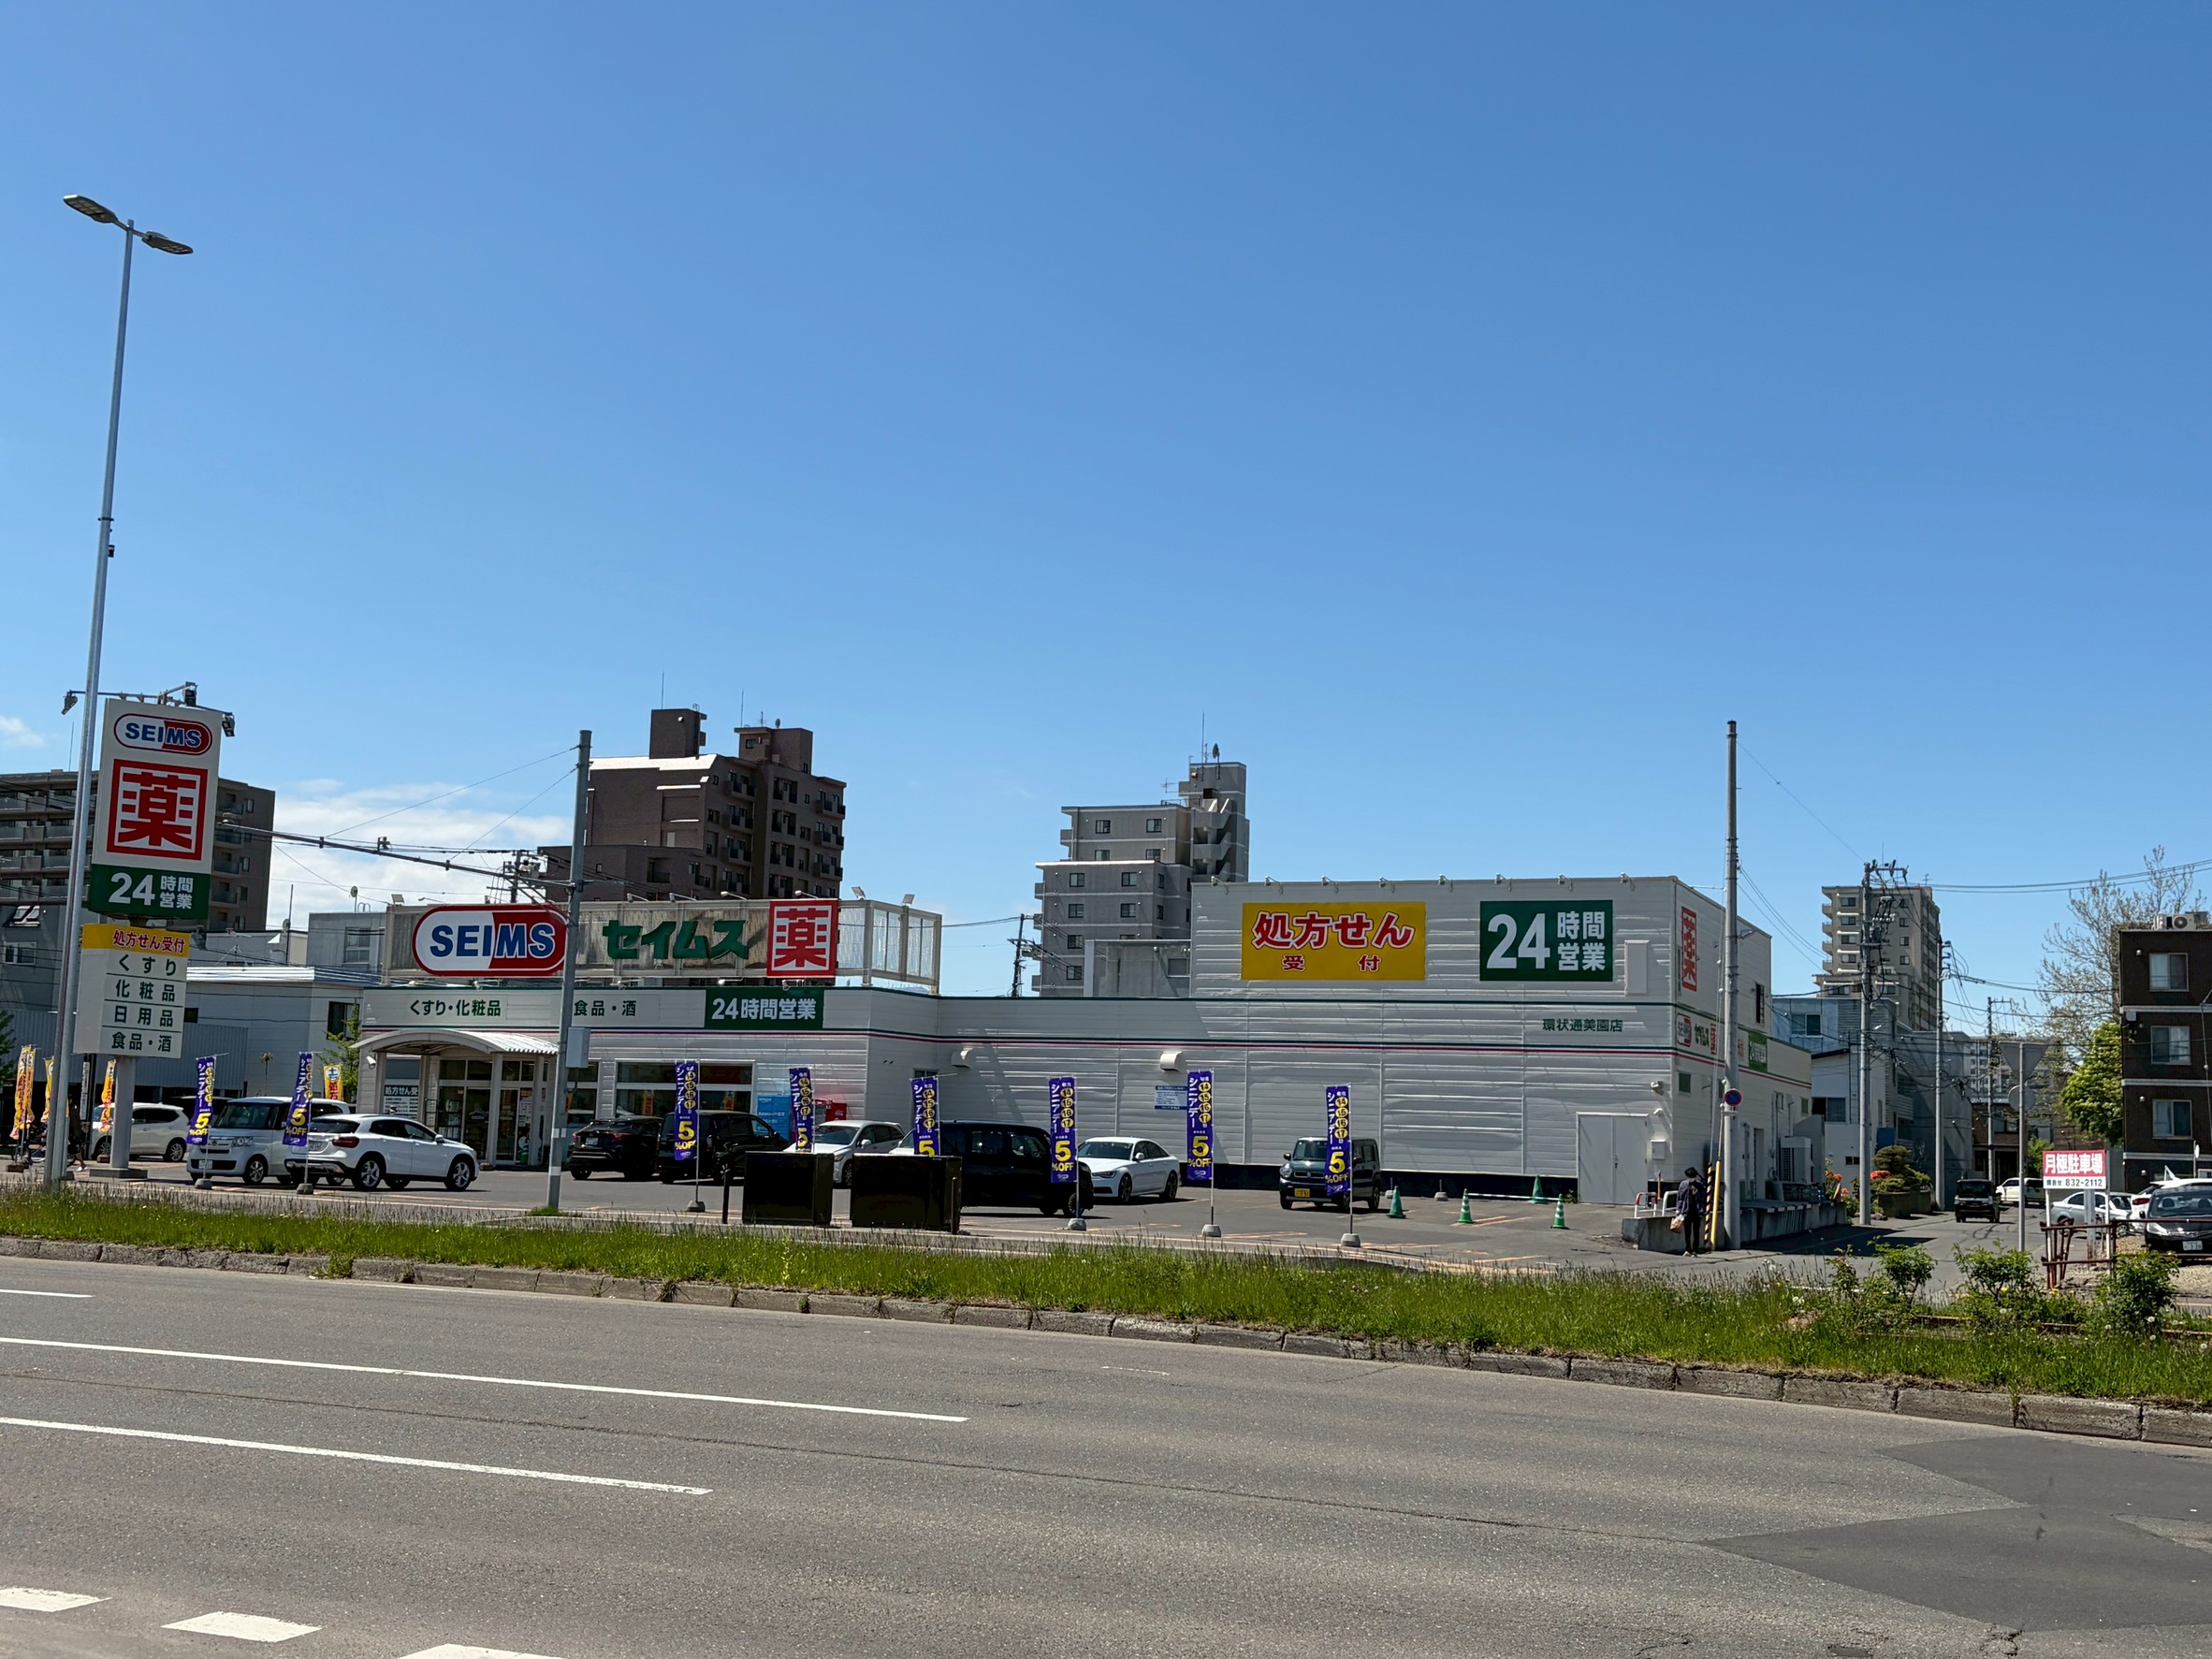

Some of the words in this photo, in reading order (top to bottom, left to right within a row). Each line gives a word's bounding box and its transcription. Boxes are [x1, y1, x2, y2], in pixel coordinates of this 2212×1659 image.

[124, 721, 202, 748] SEIMS
[116, 769, 198, 851] 薬
[109, 872, 155, 907] 24
[160, 875, 194, 893] 時間
[159, 893, 193, 910] 営業
[113, 929, 185, 953] 処方せん受付
[429, 922, 557, 960] SEIMS
[602, 919, 749, 960] セイムス
[773, 906, 834, 974] 薬
[1252, 910, 1415, 952] 処方せん
[1486, 913, 1550, 969] 24
[1557, 910, 1606, 940] 時間
[118, 953, 177, 976] くすり
[1557, 942, 1607, 971] 営業
[115, 979, 175, 1002] 化粧品
[114, 1005, 173, 1027] 日用品
[410, 999, 502, 1017] くすり・化粧品
[574, 999, 637, 1017] 食品・酒
[711, 997, 817, 1020] 24時間営業
[1542, 1018, 1623, 1032] 環状通美園店
[111, 1031, 172, 1053] 食品・酒
[913, 1084, 924, 1133] シニアデー
[1051, 1084, 1061, 1133] シニアデー
[1188, 1077, 1199, 1128] シニアデー
[195, 1113, 211, 1129] 5
[290, 1108, 307, 1127] 5
[1327, 1092, 1335, 1144] シニアデー
[677, 1120, 695, 1141] 5
[797, 1128, 808, 1147] 5
[1055, 1140, 1071, 1162] 5
[1192, 1135, 1210, 1157] 5
[1051, 1162, 1074, 1171] %OFF
[1329, 1151, 1346, 1173] 5
[2045, 1153, 2103, 1174] 月極駐車場
[2065, 1178, 2103, 1186] 832-2112
